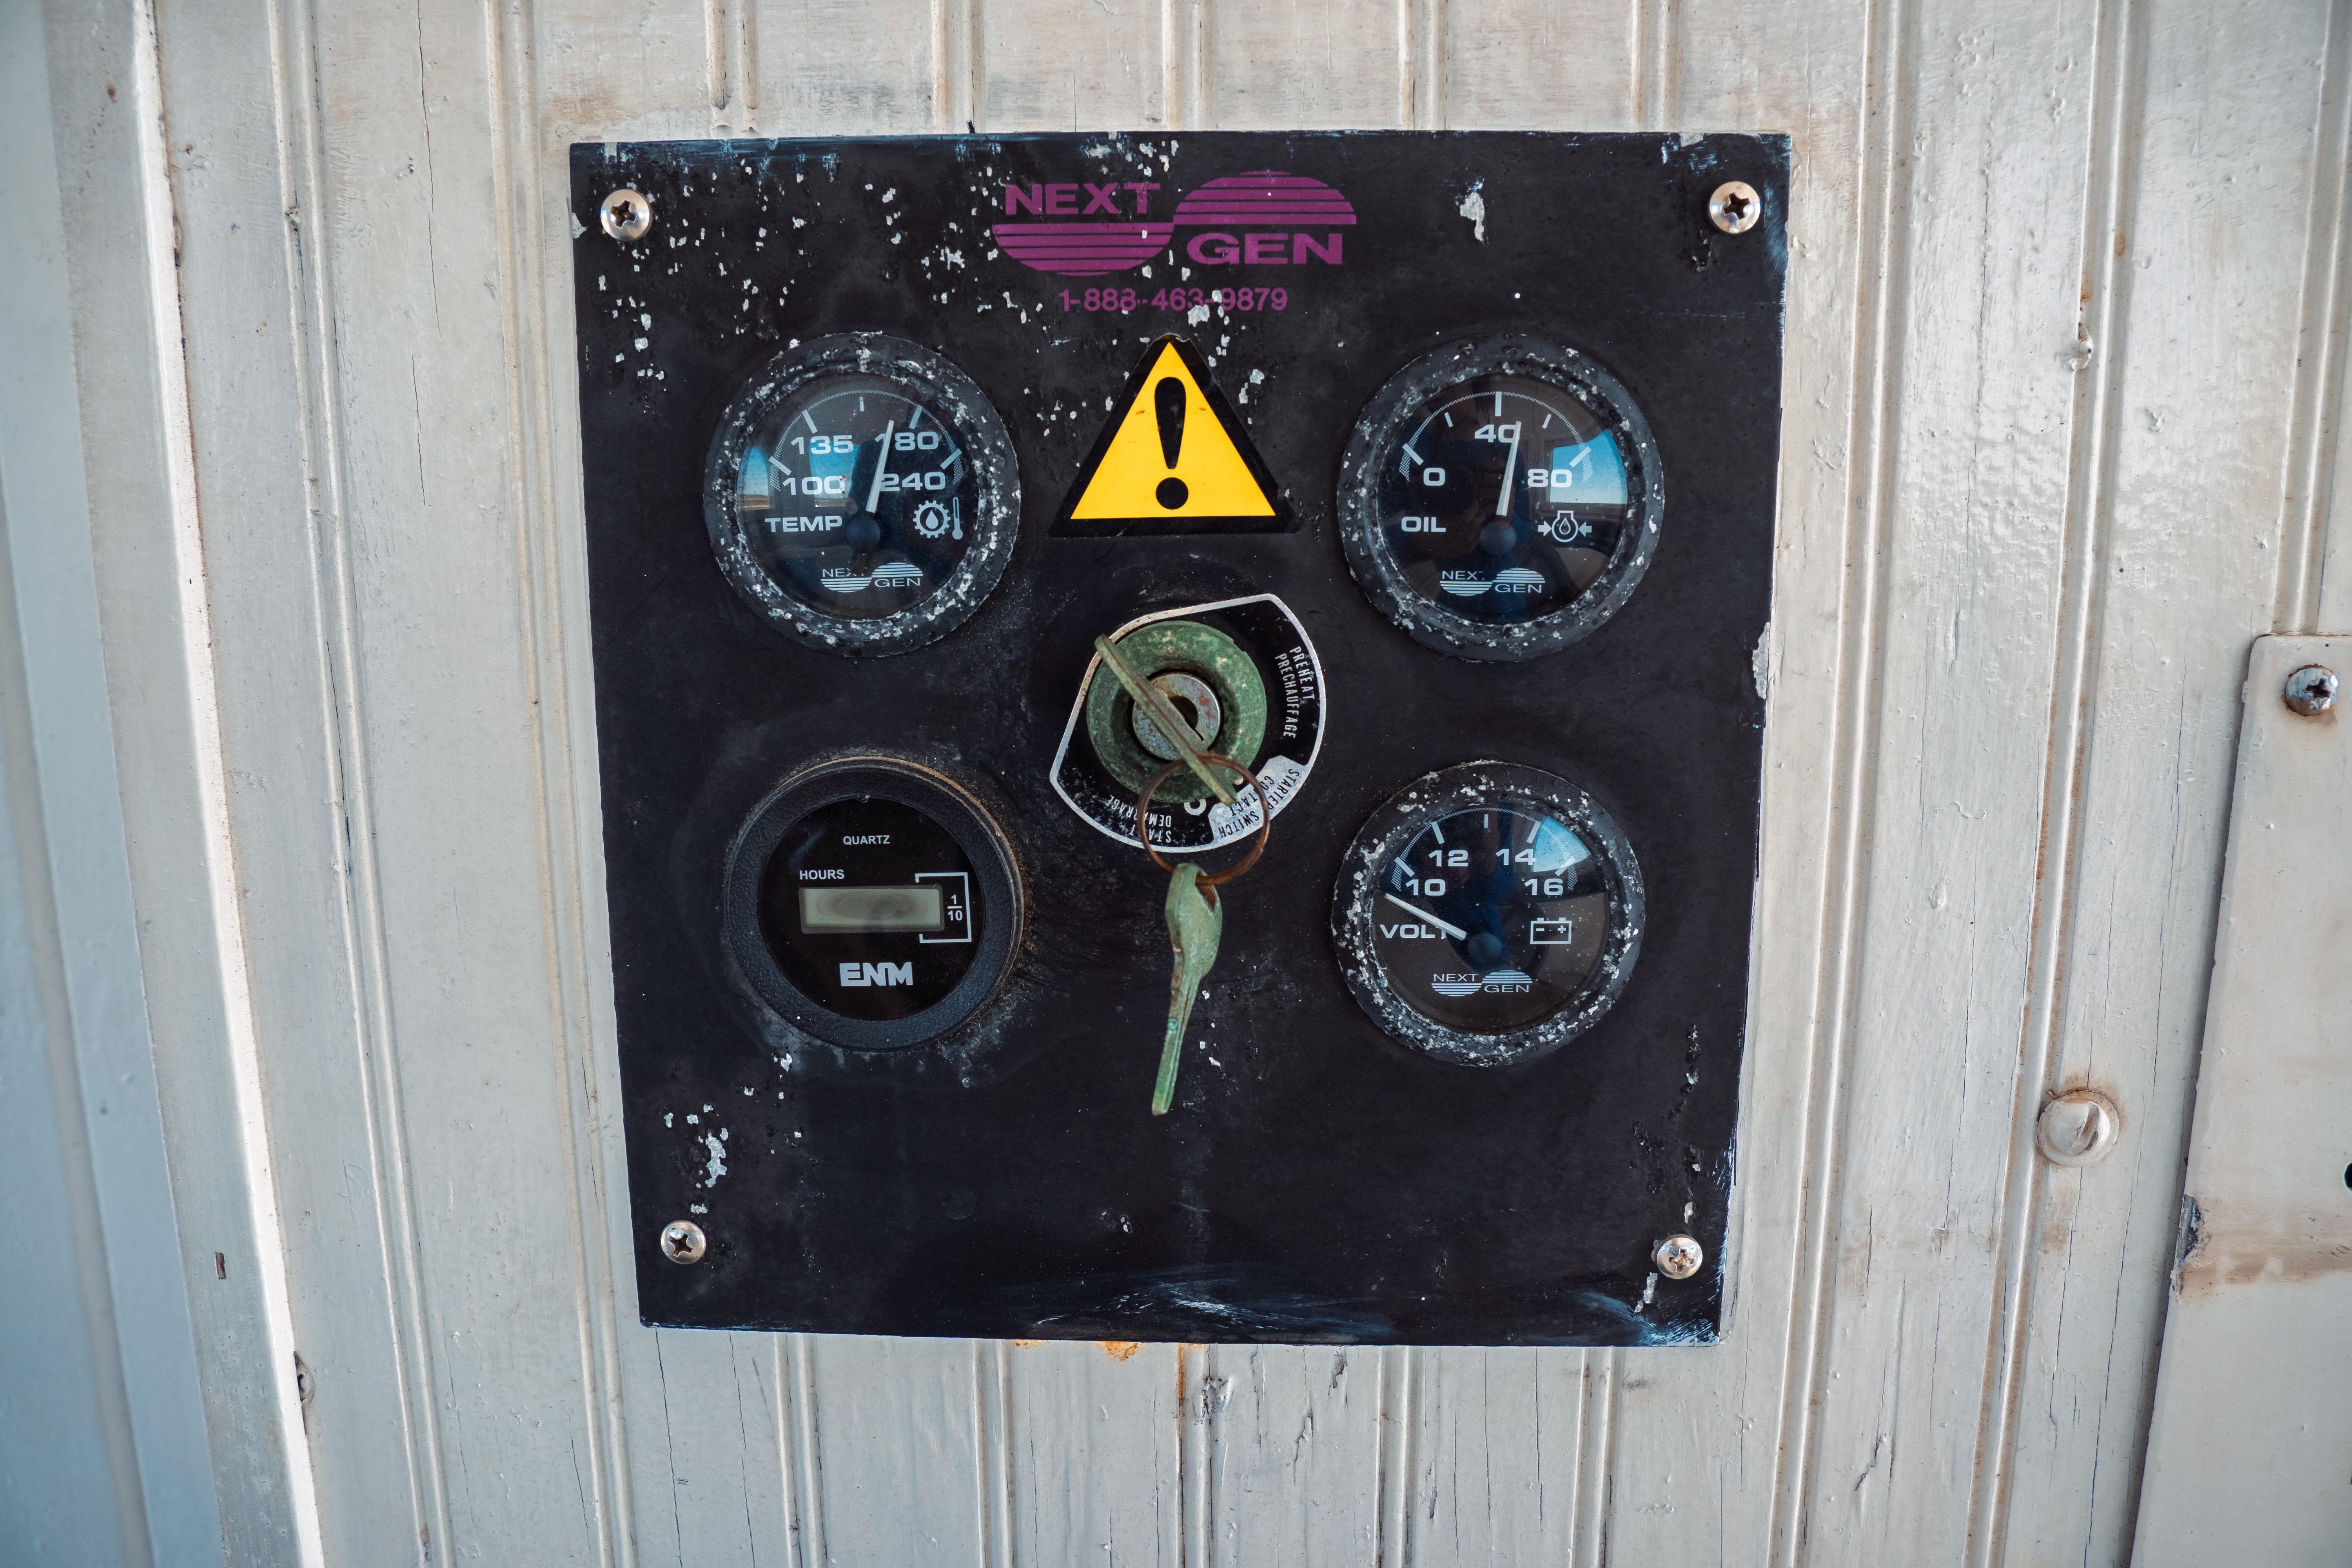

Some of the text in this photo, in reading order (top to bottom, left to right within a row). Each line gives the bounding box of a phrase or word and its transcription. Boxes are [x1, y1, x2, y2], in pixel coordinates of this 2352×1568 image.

[1005, 183, 1161, 215] NEXT
[1186, 232, 1343, 265] GEN
[1059, 287, 1288, 311] 1-888-463-9879
[1475, 424, 1520, 443] 40
[791, 435, 853, 454] 135
[782, 476, 846, 495] 100
[880, 472, 946, 492] 240
[1423, 467, 1445, 486] 0
[1528, 469, 1572, 488] 80
[765, 515, 842, 532] TEMP
[1401, 516, 1446, 532] OIL
[822, 567, 868, 577] NEX
[1442, 571, 1485, 580] NEX
[874, 577, 921, 587] GEN
[1495, 583, 1542, 593] GEN
[1290, 646, 1315, 699] PREHEAT
[1275, 653, 1299, 738] PRECHAUFFAGE
[1218, 769, 1300, 838] STARTER SWITCH
[1229, 775, 1274, 816] COTACT
[843, 835, 890, 845] QUARTZ
[1129, 824, 1172, 843] STAT
[1428, 849, 1468, 867] 12
[1496, 848, 1536, 866] 14
[799, 869, 845, 880] HOURS
[1405, 878, 1446, 896] 10
[1524, 878, 1563, 896] 16
[839, 962, 913, 986] ENM
[1434, 973, 1479, 982] NEXT
[1484, 984, 1529, 993] GEN
